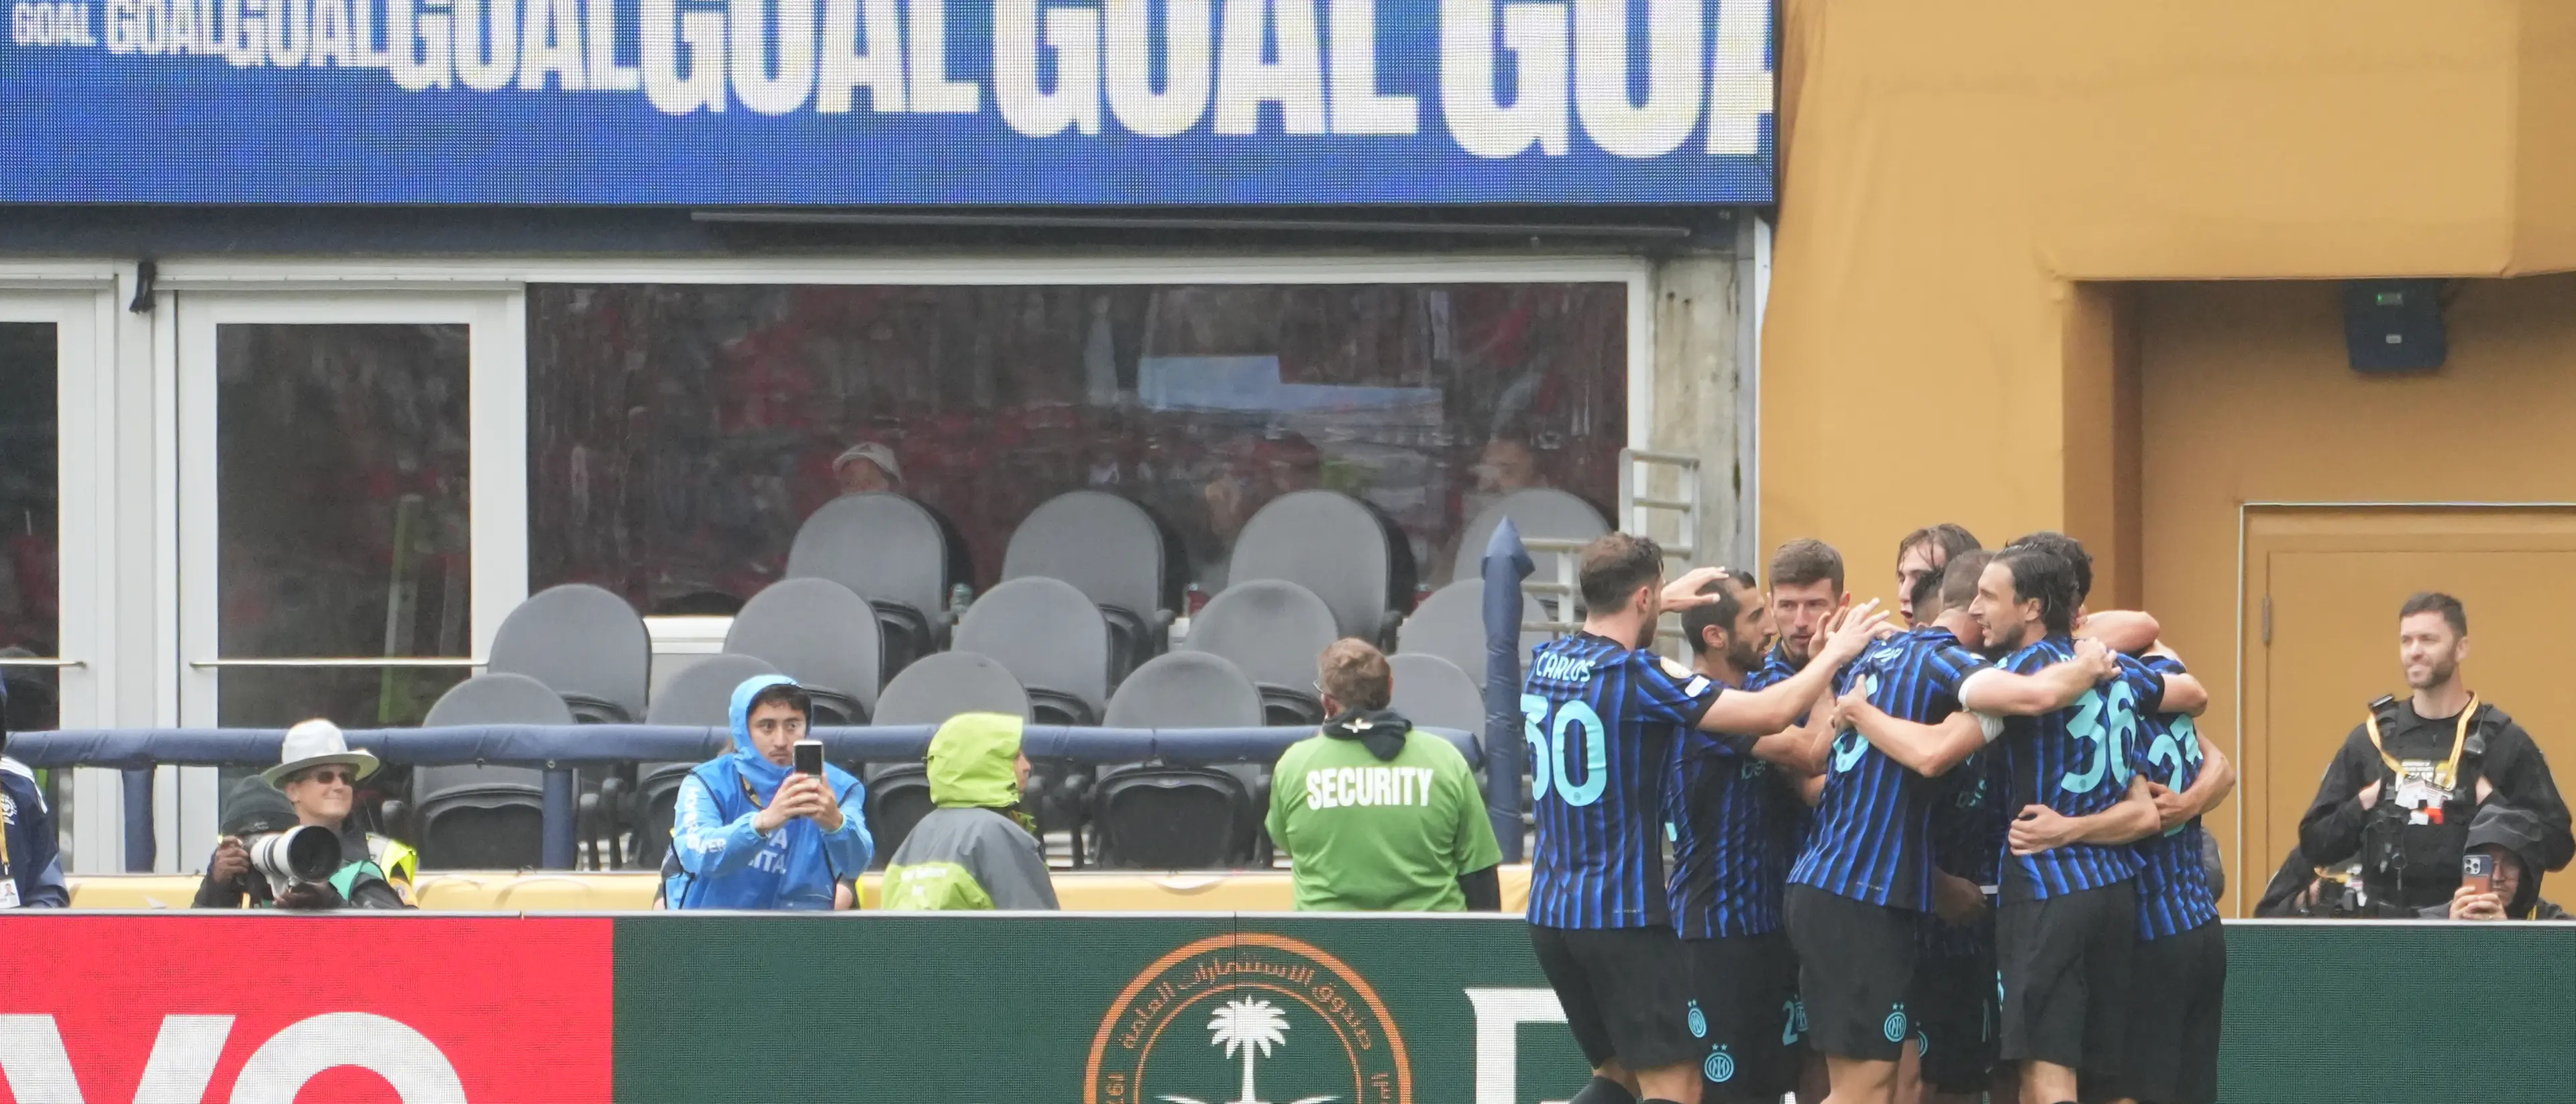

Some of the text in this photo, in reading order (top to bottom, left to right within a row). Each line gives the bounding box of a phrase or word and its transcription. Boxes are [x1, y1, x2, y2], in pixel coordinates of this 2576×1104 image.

[13, 3, 97, 45] GOAL
[105, 0, 229, 54] GOAL
[225, 0, 393, 68] GOAL
[388, 0, 640, 91] GOAL
[642, 0, 981, 115] GOAL
[993, 0, 1418, 138] GOAL
[1536, 651, 1595, 683] CARLOS
[1305, 766, 1434, 811] SECURITY
[1520, 693, 1607, 807] 30
[2061, 681, 2137, 793] 36
